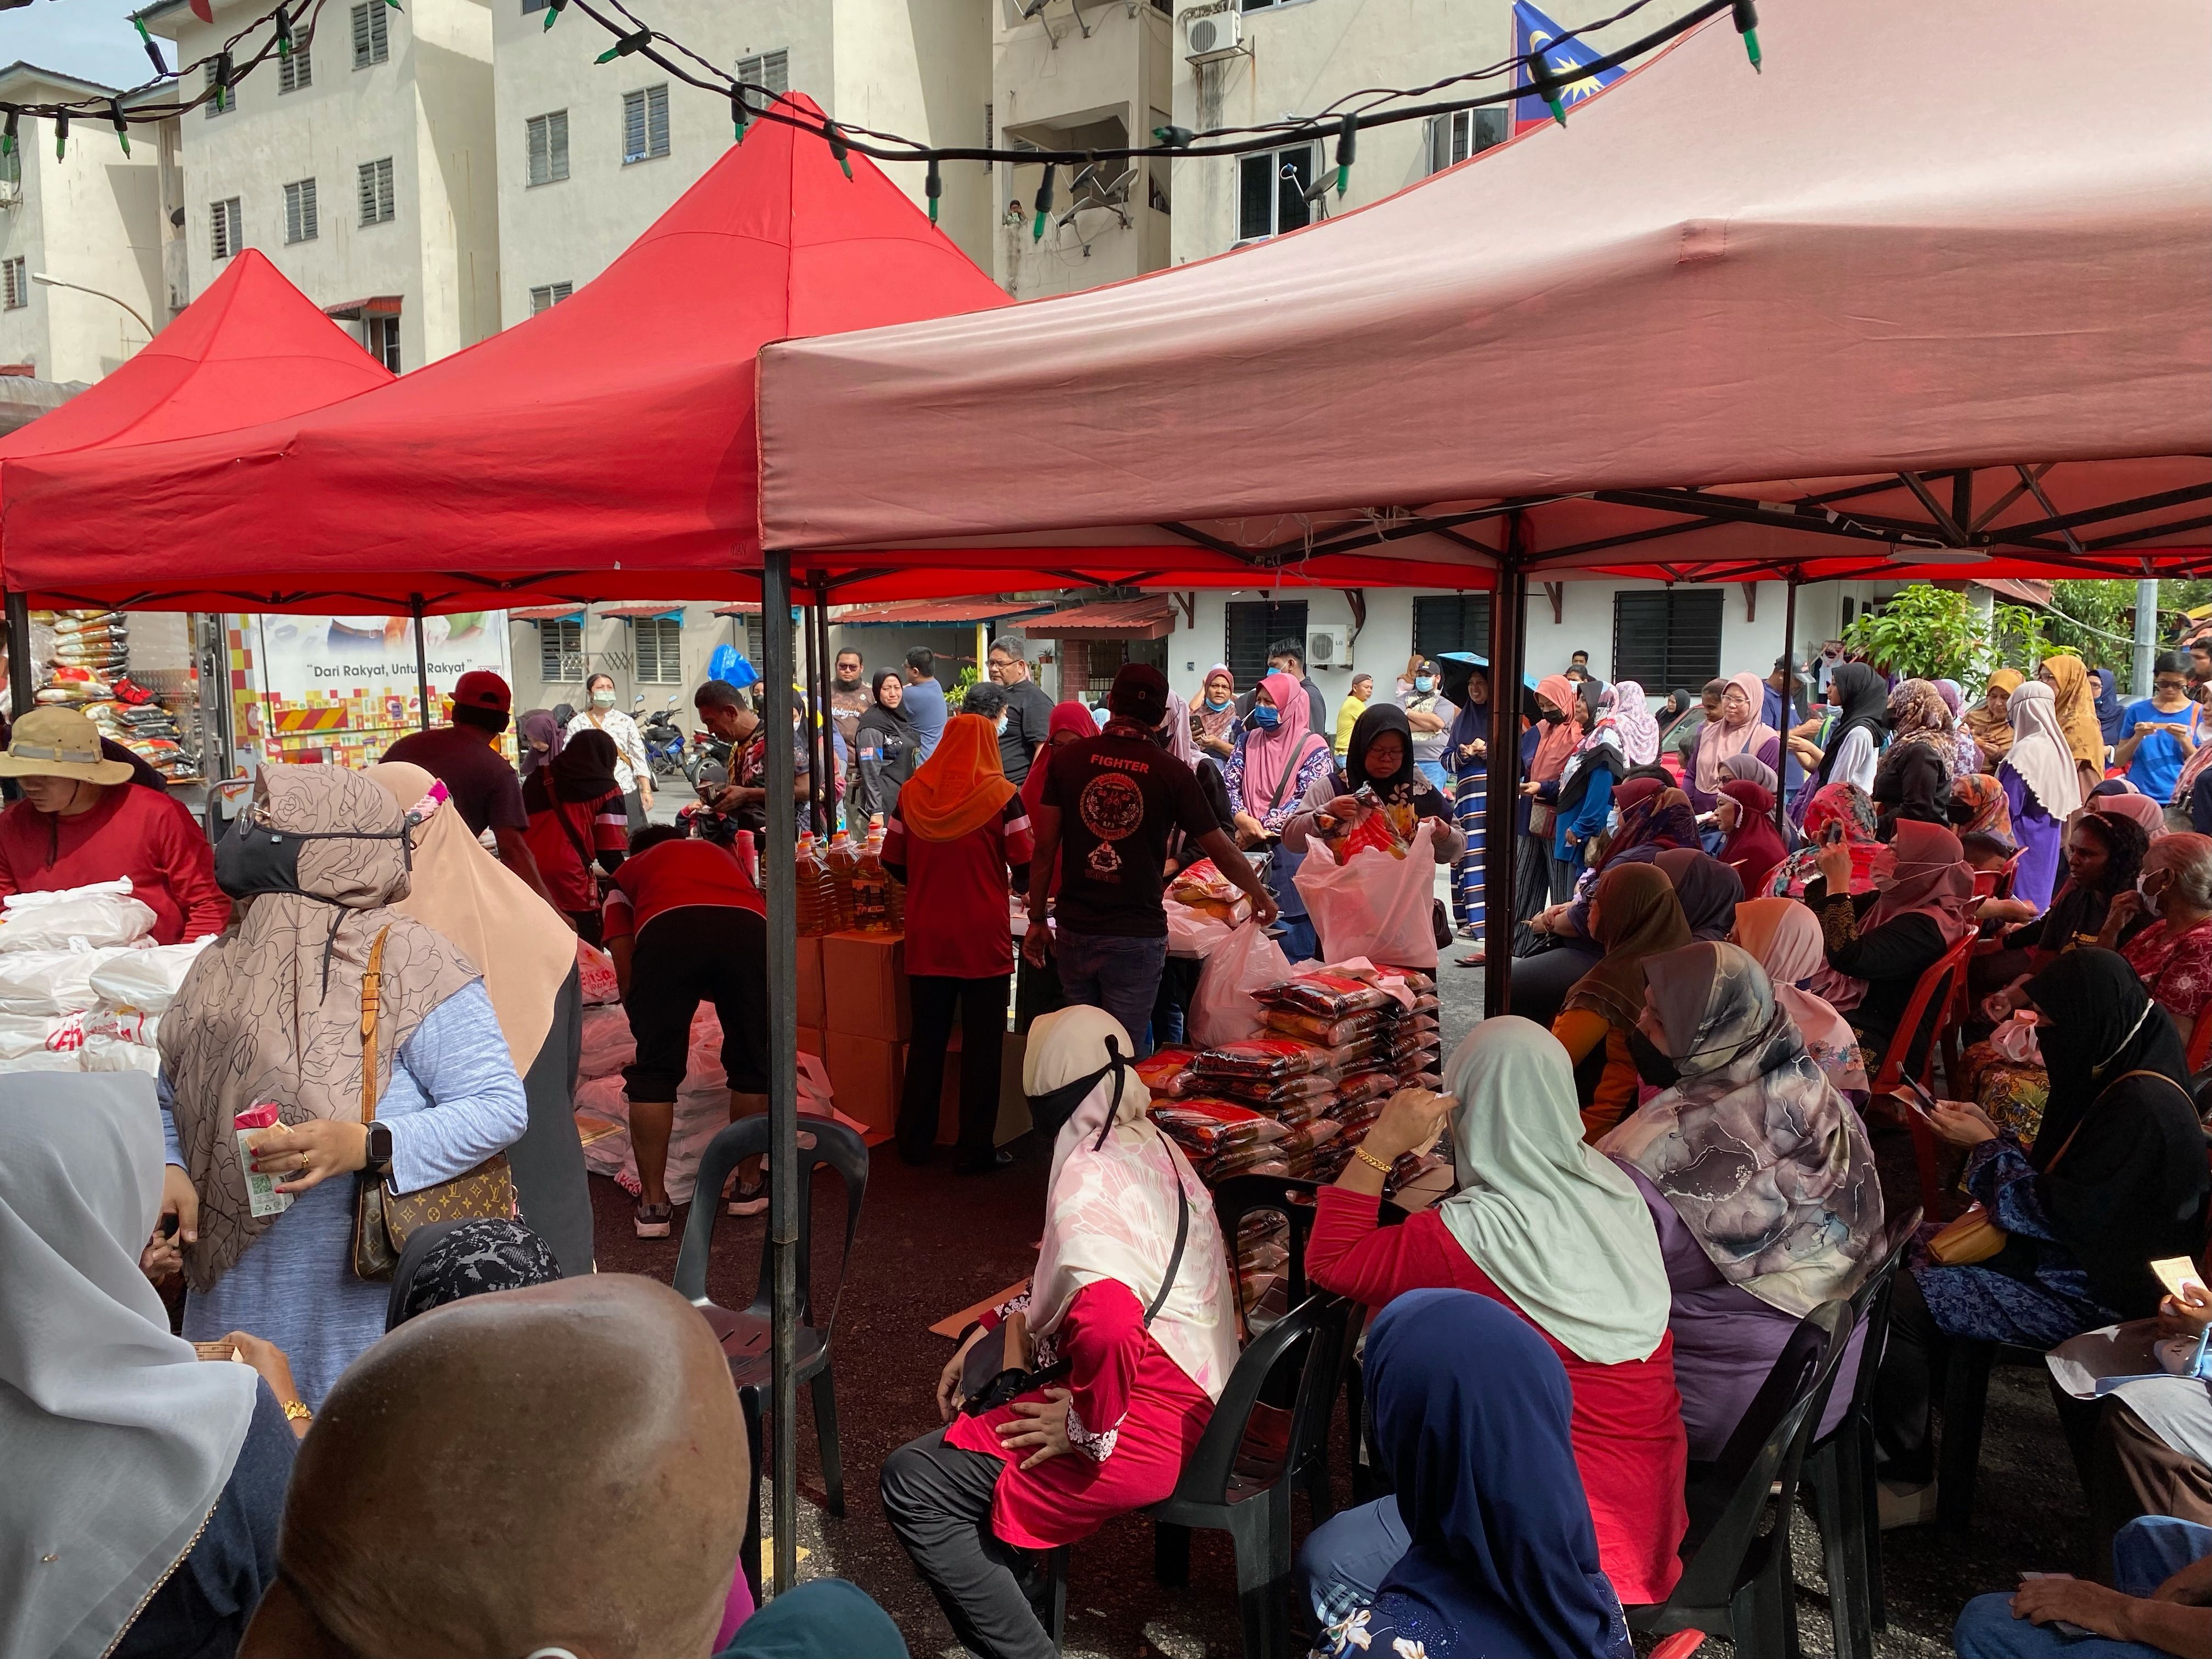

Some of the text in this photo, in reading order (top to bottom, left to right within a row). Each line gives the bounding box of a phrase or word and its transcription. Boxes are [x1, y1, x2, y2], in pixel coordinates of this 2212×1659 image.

[343, 664, 388, 678] Rakyat,
[392, 664, 417, 675] Untu
[1090, 754, 1149, 774] FIGHTER
